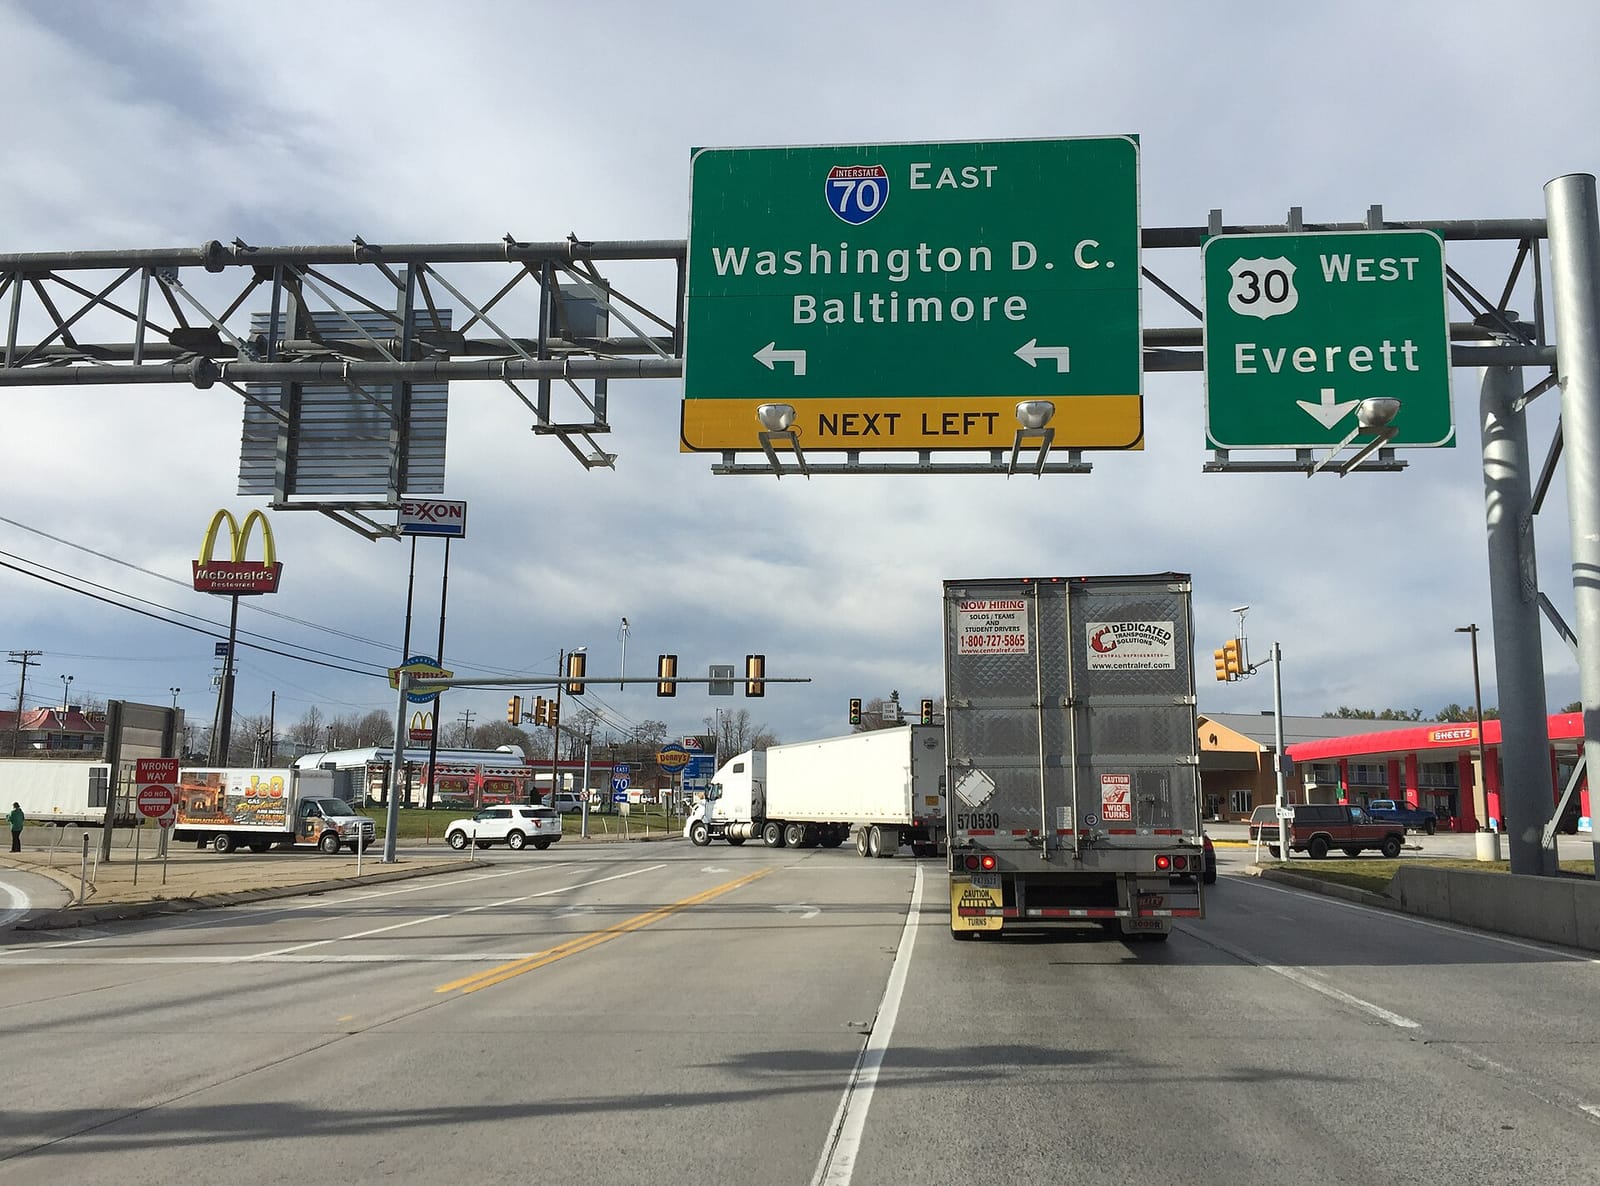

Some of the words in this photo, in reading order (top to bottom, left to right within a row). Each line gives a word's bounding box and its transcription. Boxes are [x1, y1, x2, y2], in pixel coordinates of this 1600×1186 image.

[835, 167, 880, 178] INTERSTATE
[909, 162, 998, 191] EAST
[833, 180, 880, 213] 70
[712, 242, 993, 281] Washington
[1011, 240, 1054, 271] D.
[1073, 239, 1116, 270] C.
[1319, 253, 1420, 283] WEST
[1235, 269, 1290, 304] 30
[792, 291, 1029, 325] Baltimore
[1234, 339, 1420, 375] Everett
[818, 413, 901, 436] NEXT
[921, 412, 1000, 435] LEFT
[401, 502, 462, 522] EXXON
[195, 569, 274, 581] McDonald's
[961, 601, 987, 609] NOW
[989, 600, 1025, 609] HIRING
[1112, 622, 1172, 641] DEDICATED
[1115, 631, 1168, 647] TRANSPORTATION
[1116, 637, 1153, 646] SOLUTIONS
[1092, 661, 1170, 670] www.centralref.com
[1435, 730, 1471, 739] SHEETZ
[660, 753, 688, 762] Denny's
[614, 779, 628, 789] 70
[957, 813, 999, 829] 570530
[968, 918, 987, 926] TURNS
